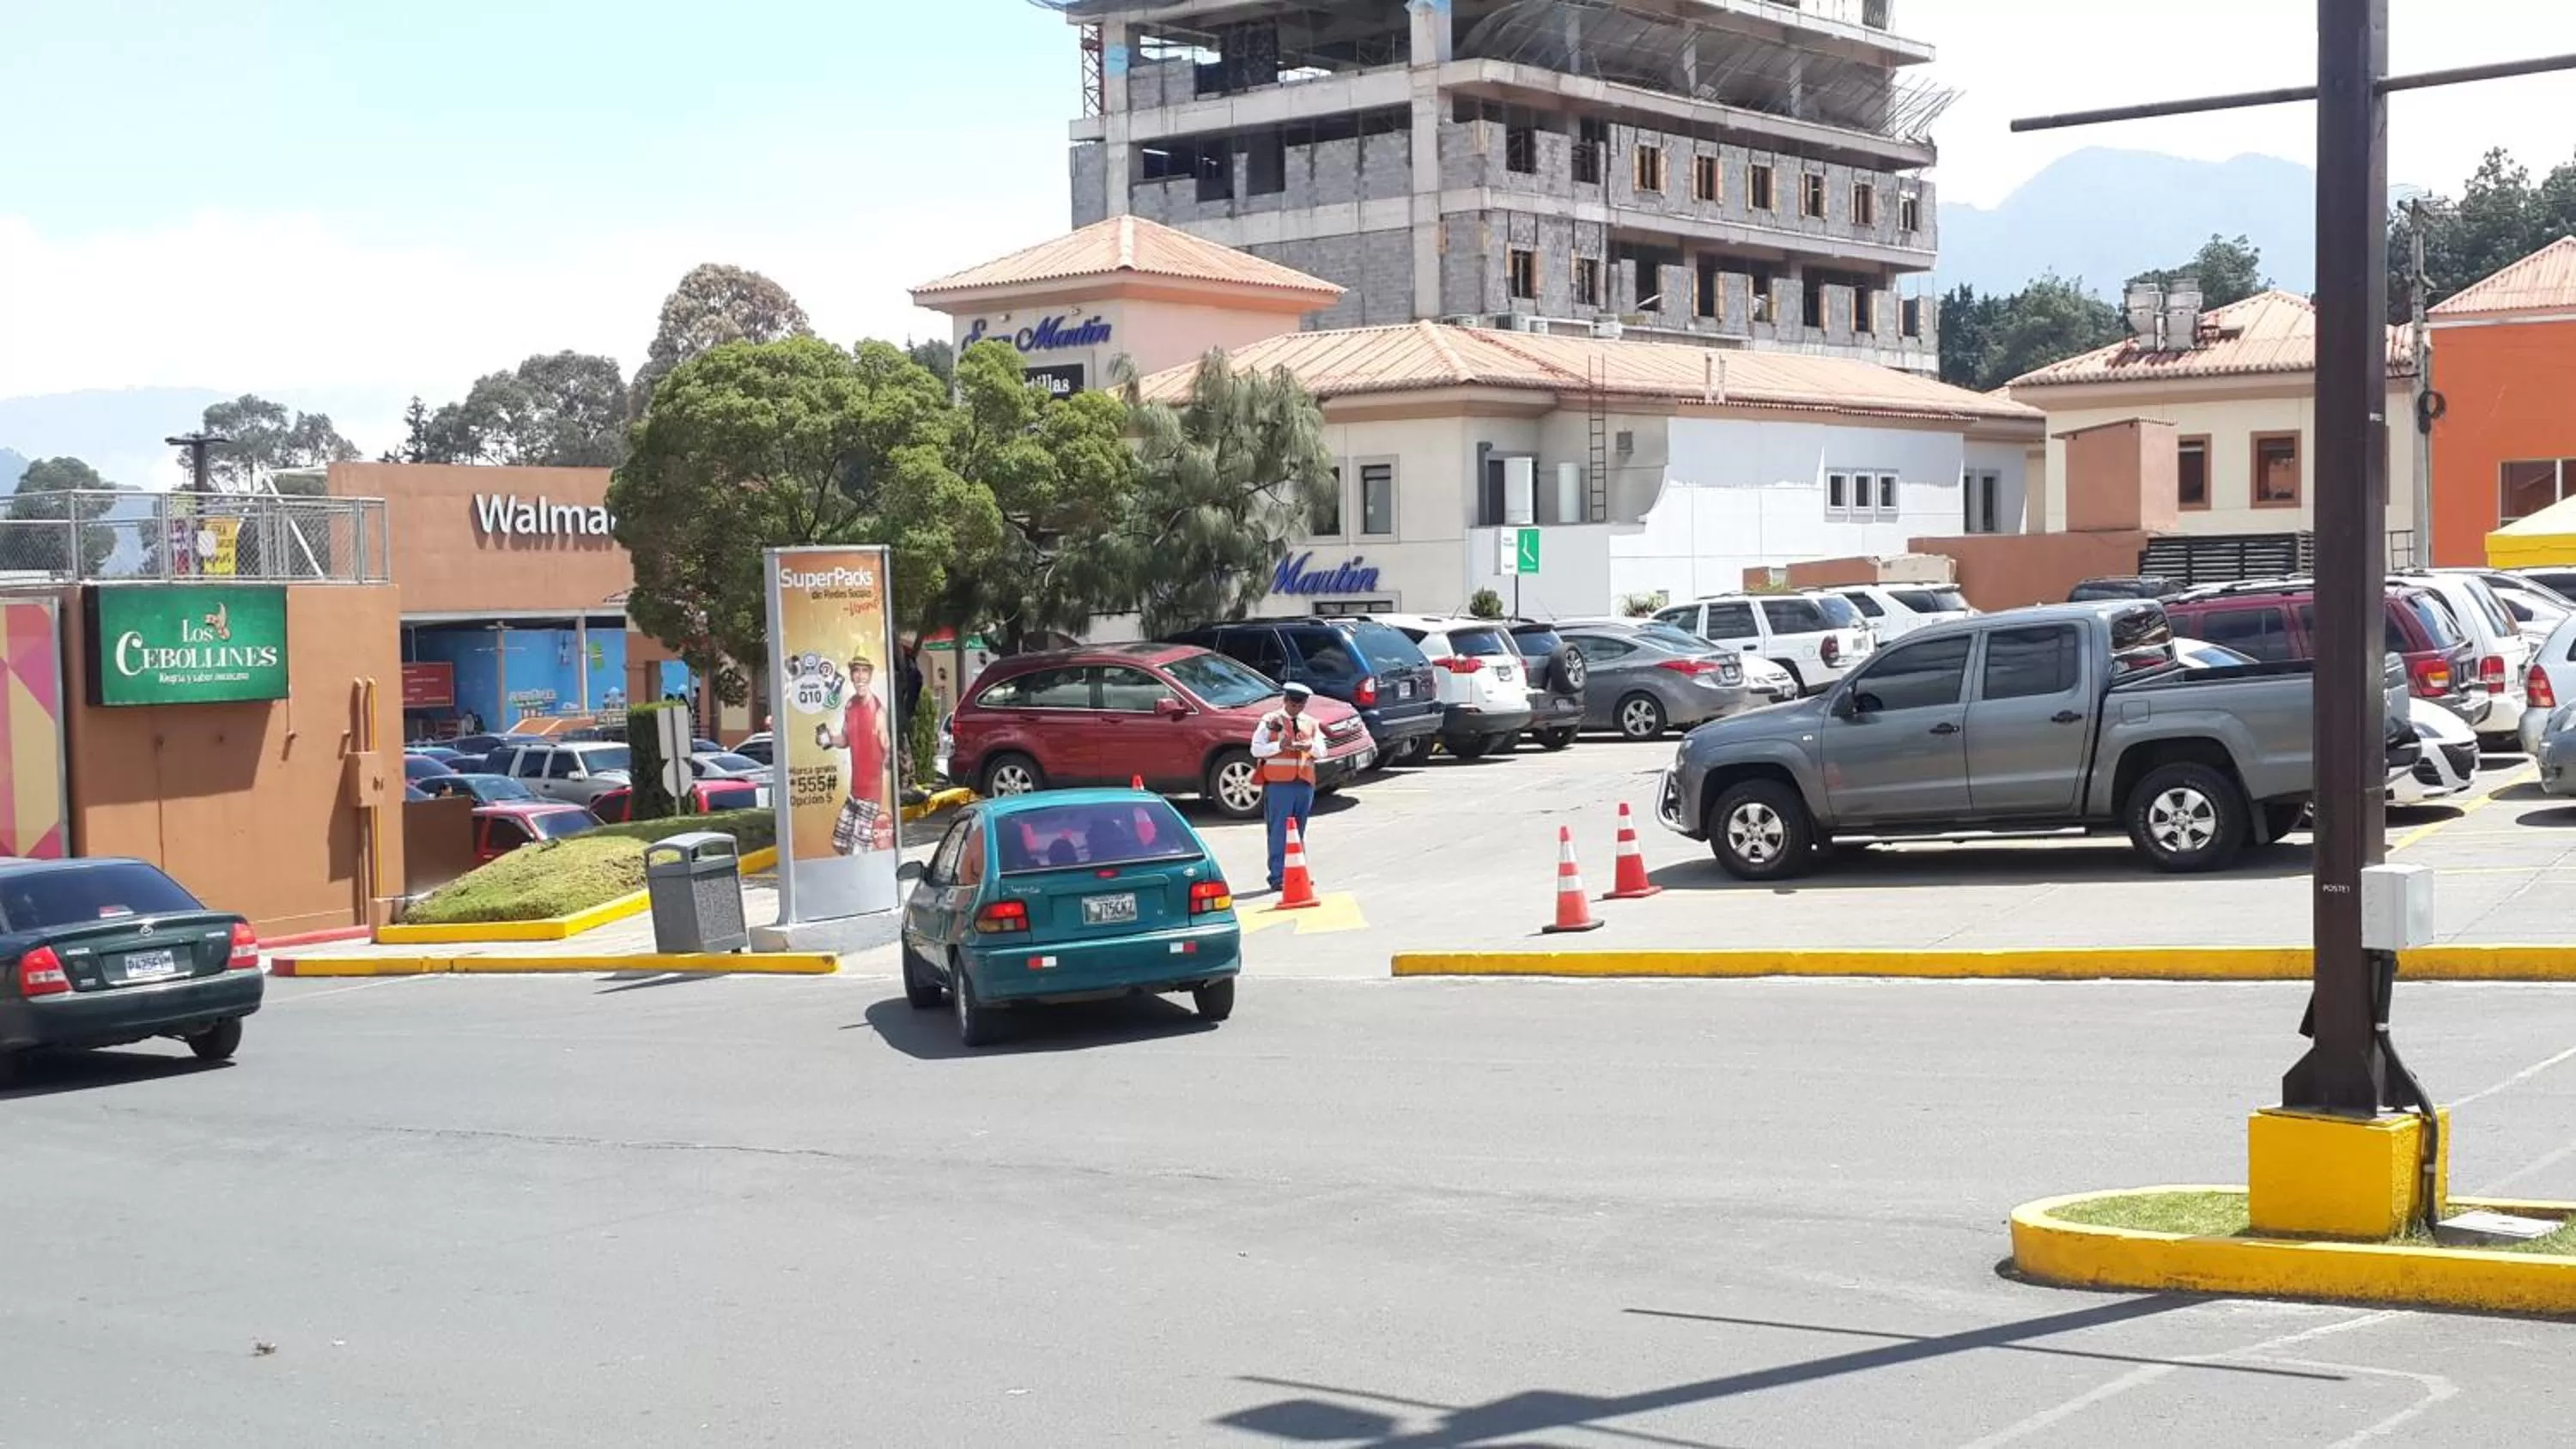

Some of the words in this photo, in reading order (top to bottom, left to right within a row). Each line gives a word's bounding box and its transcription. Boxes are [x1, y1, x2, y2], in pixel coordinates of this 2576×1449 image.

[780, 567, 873, 591] SuperPacks
[183, 619, 214, 643] Los
[116, 631, 277, 676] CEBOLLINES
[799, 690, 822, 703] Q10
